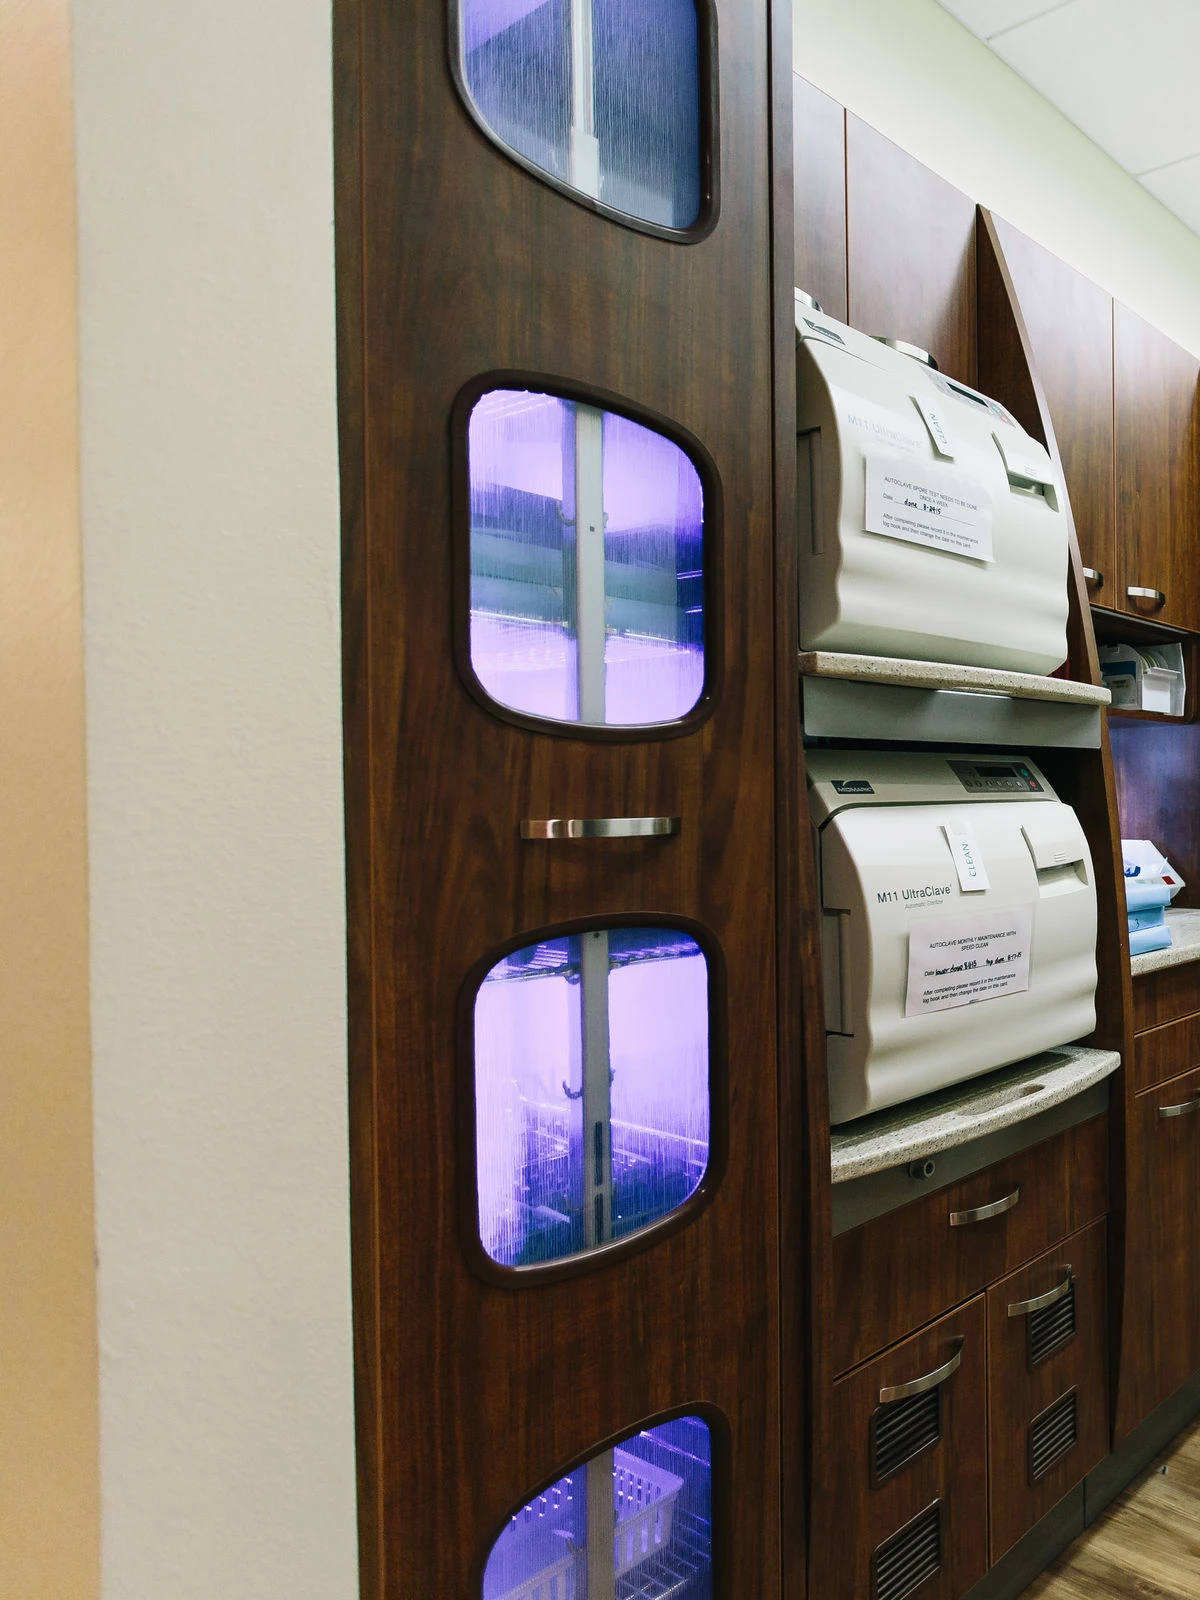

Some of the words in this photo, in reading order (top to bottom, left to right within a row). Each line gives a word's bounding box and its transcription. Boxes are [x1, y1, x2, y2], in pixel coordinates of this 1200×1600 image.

[885, 476, 912, 490] AUTOCLAVE
[940, 494, 954, 503] NEEDS
[966, 502, 978, 511] DONE
[904, 498, 918, 508] done
[936, 499, 948, 508] WEEK
[894, 516, 916, 527] completing
[917, 522, 930, 530] please
[931, 526, 942, 534] record
[957, 533, 979, 544] maintenance
[920, 531, 934, 539] change
[961, 843, 976, 876] CLEAN
[877, 891, 898, 903] M11
[902, 885, 951, 900] UltraClave
[930, 940, 956, 949] AUTOCLAVE
[957, 937, 977, 945] MONTHLY
[977, 932, 1005, 942] MAINTENANCE
[934, 985, 955, 994] completing
[994, 973, 1016, 981] maintenance
[959, 989, 972, 997] change
